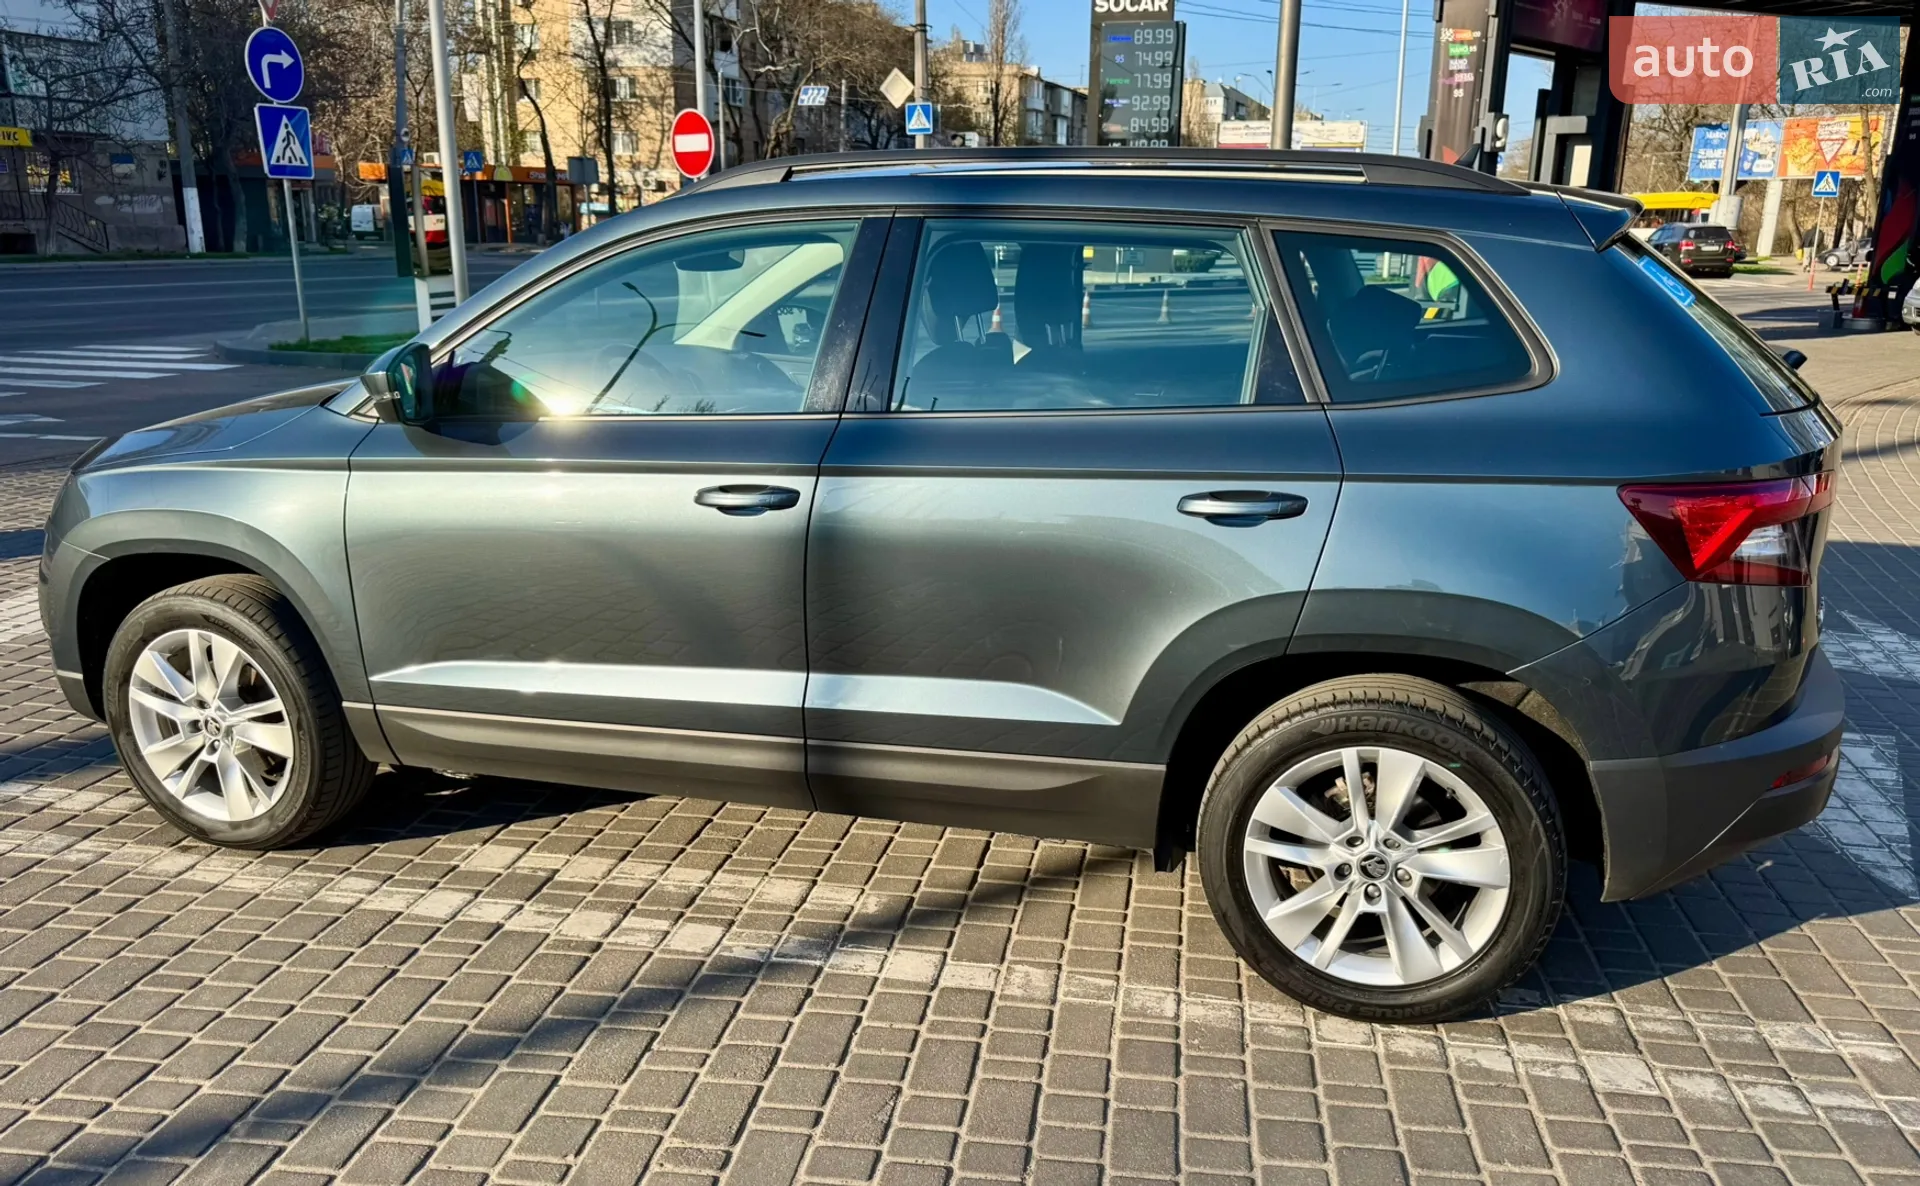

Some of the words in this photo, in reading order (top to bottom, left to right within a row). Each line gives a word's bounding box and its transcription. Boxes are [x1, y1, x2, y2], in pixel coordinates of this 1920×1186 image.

[1094, 0, 1168, 12] SOCAR
[1133, 28, 1174, 45] 89.99
[1134, 50, 1173, 67] 74.99
[1133, 73, 1172, 89] 77.99
[1131, 95, 1171, 111] 92.99
[1129, 117, 1169, 133] 84.99
